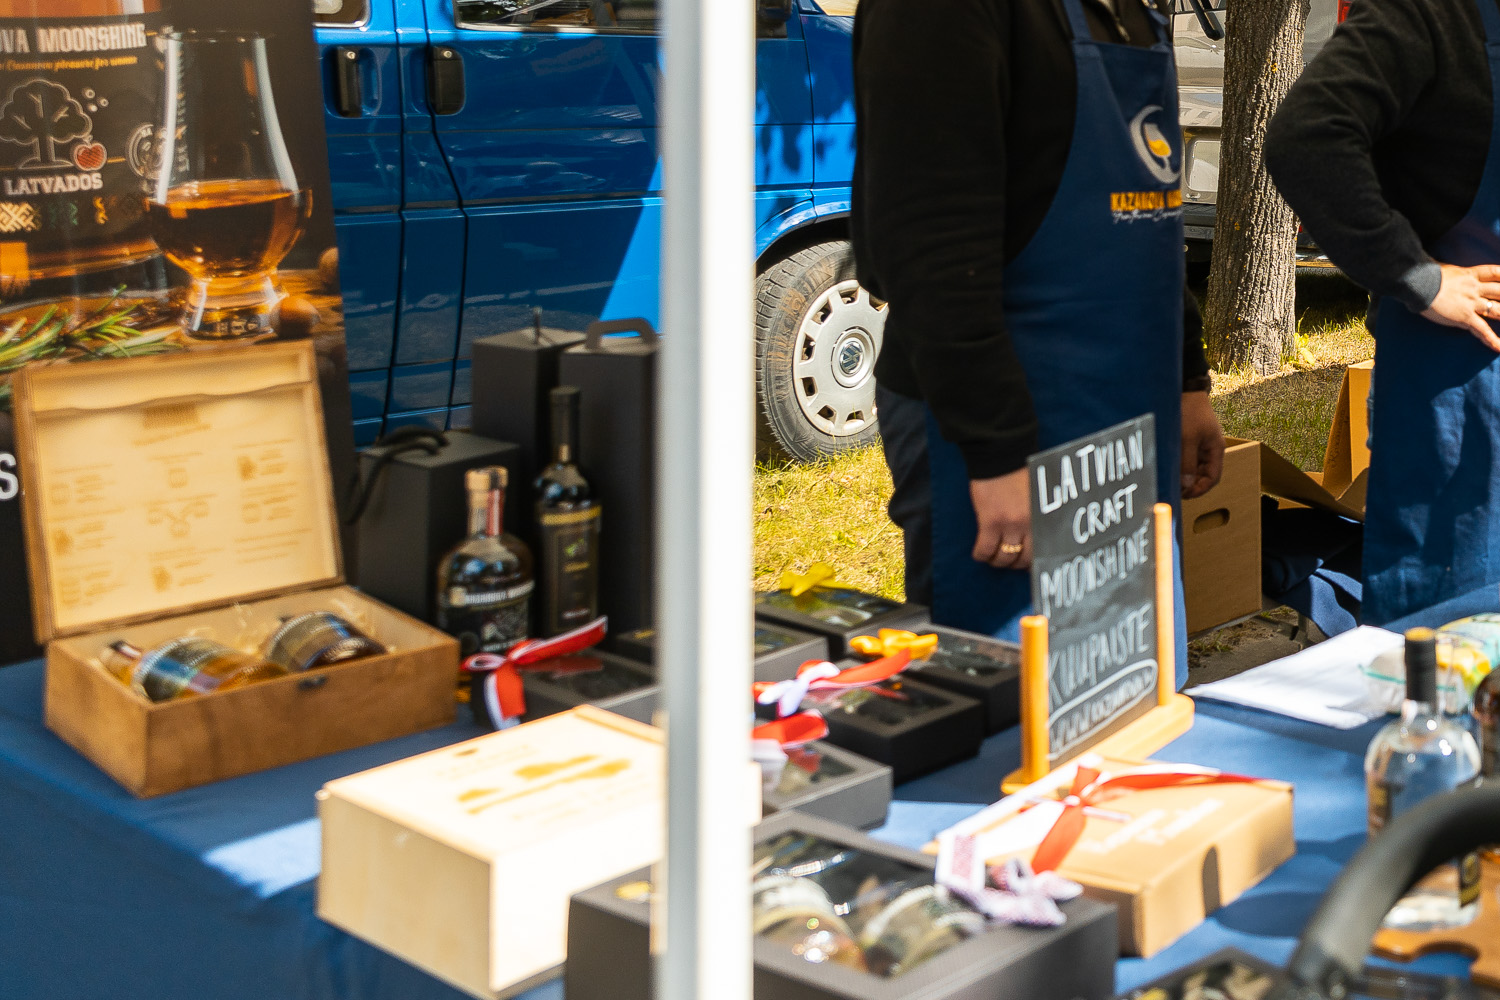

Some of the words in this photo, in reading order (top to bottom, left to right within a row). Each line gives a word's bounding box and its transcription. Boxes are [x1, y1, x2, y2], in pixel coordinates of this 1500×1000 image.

[37, 23, 147, 53] MOONSHINE
[4, 172, 104, 195] LATVADOS
[1037, 430, 1144, 514] LATVIAN
[1072, 483, 1138, 544] CRAFT
[1040, 517, 1150, 620] MOONSHINE
